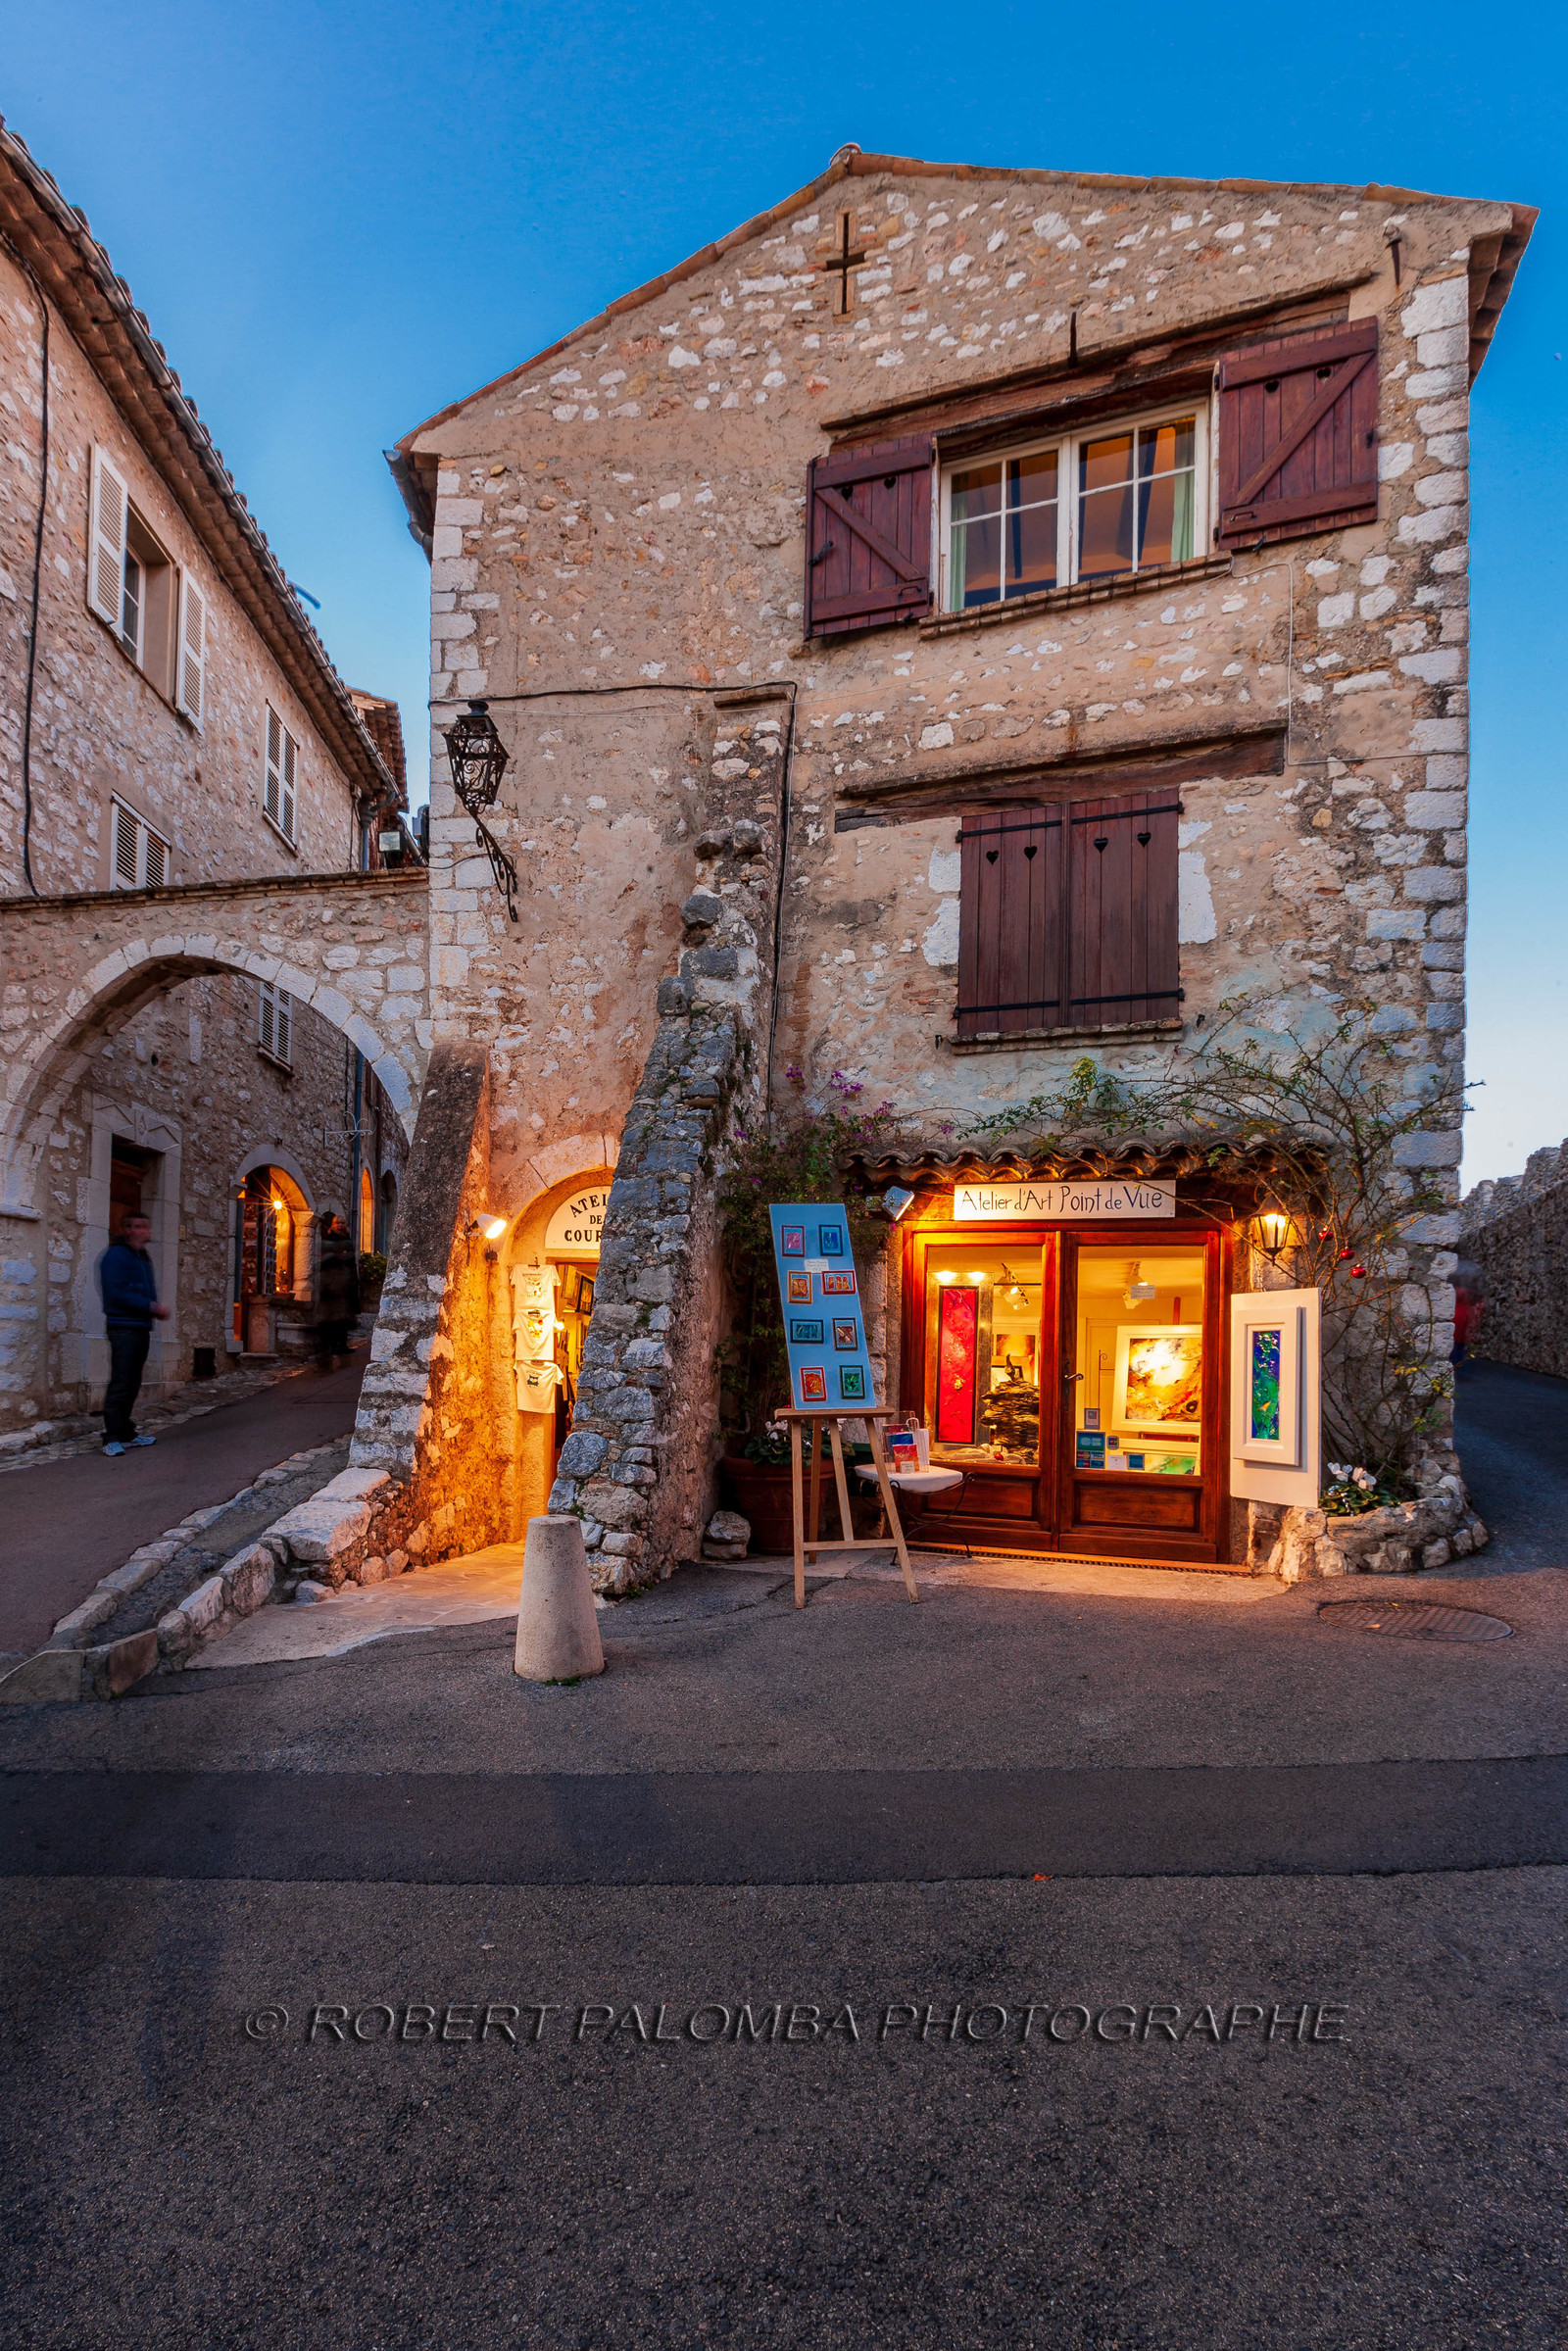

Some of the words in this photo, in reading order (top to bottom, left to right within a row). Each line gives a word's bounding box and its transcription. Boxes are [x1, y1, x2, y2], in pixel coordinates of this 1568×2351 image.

[960, 1190, 1012, 1210] Atelier
[1014, 1188, 1054, 1211] d'Art
[1059, 1185, 1102, 1213] Point
[1104, 1187, 1122, 1210] de
[1123, 1185, 1163, 1209] Vue
